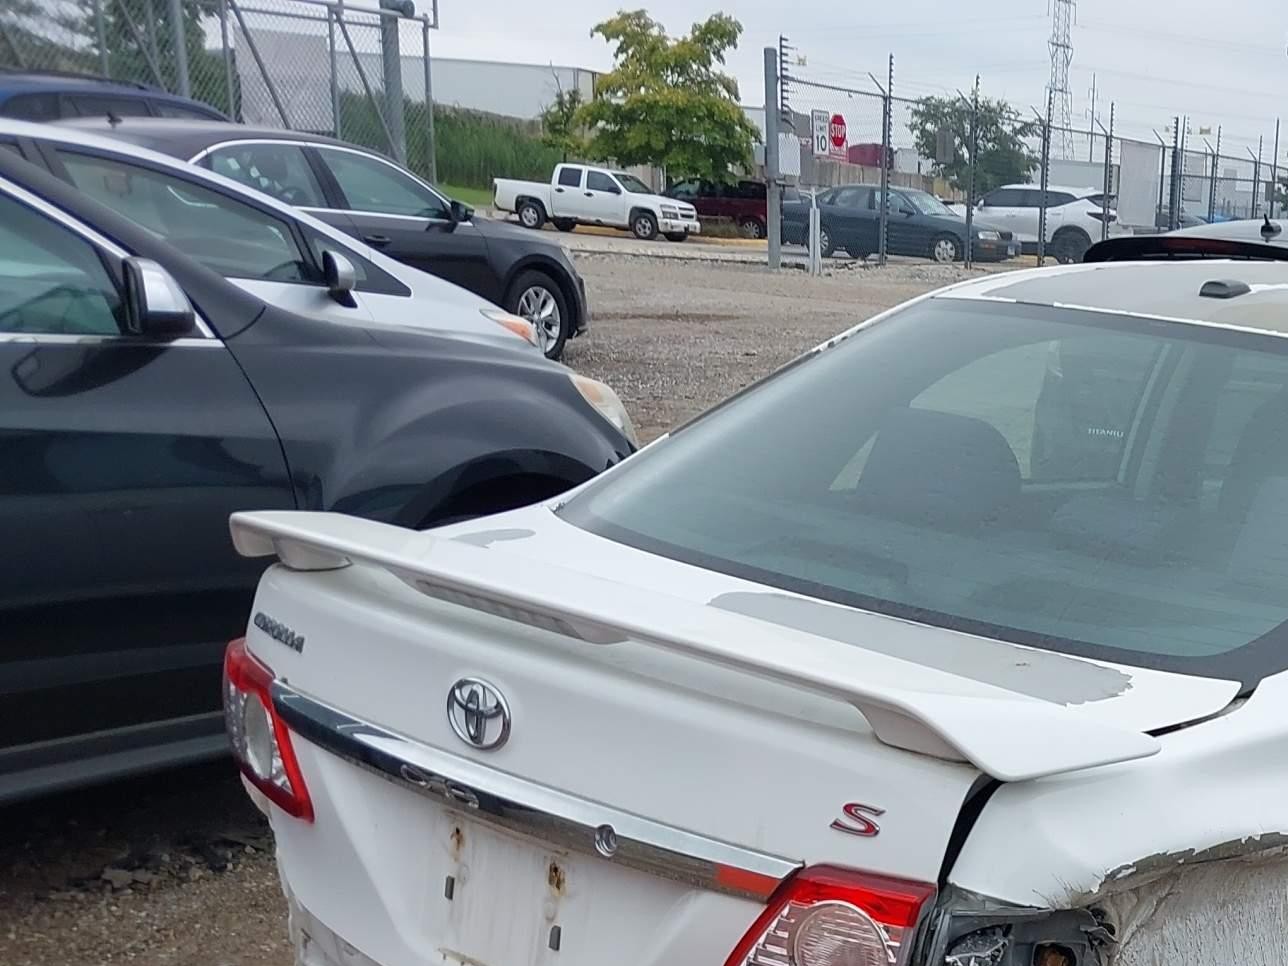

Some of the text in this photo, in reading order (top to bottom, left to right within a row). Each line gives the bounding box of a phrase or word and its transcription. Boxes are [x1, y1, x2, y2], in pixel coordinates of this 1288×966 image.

[831, 123, 846, 138] STOP
[816, 135, 827, 151] 10
[830, 803, 886, 837] S
